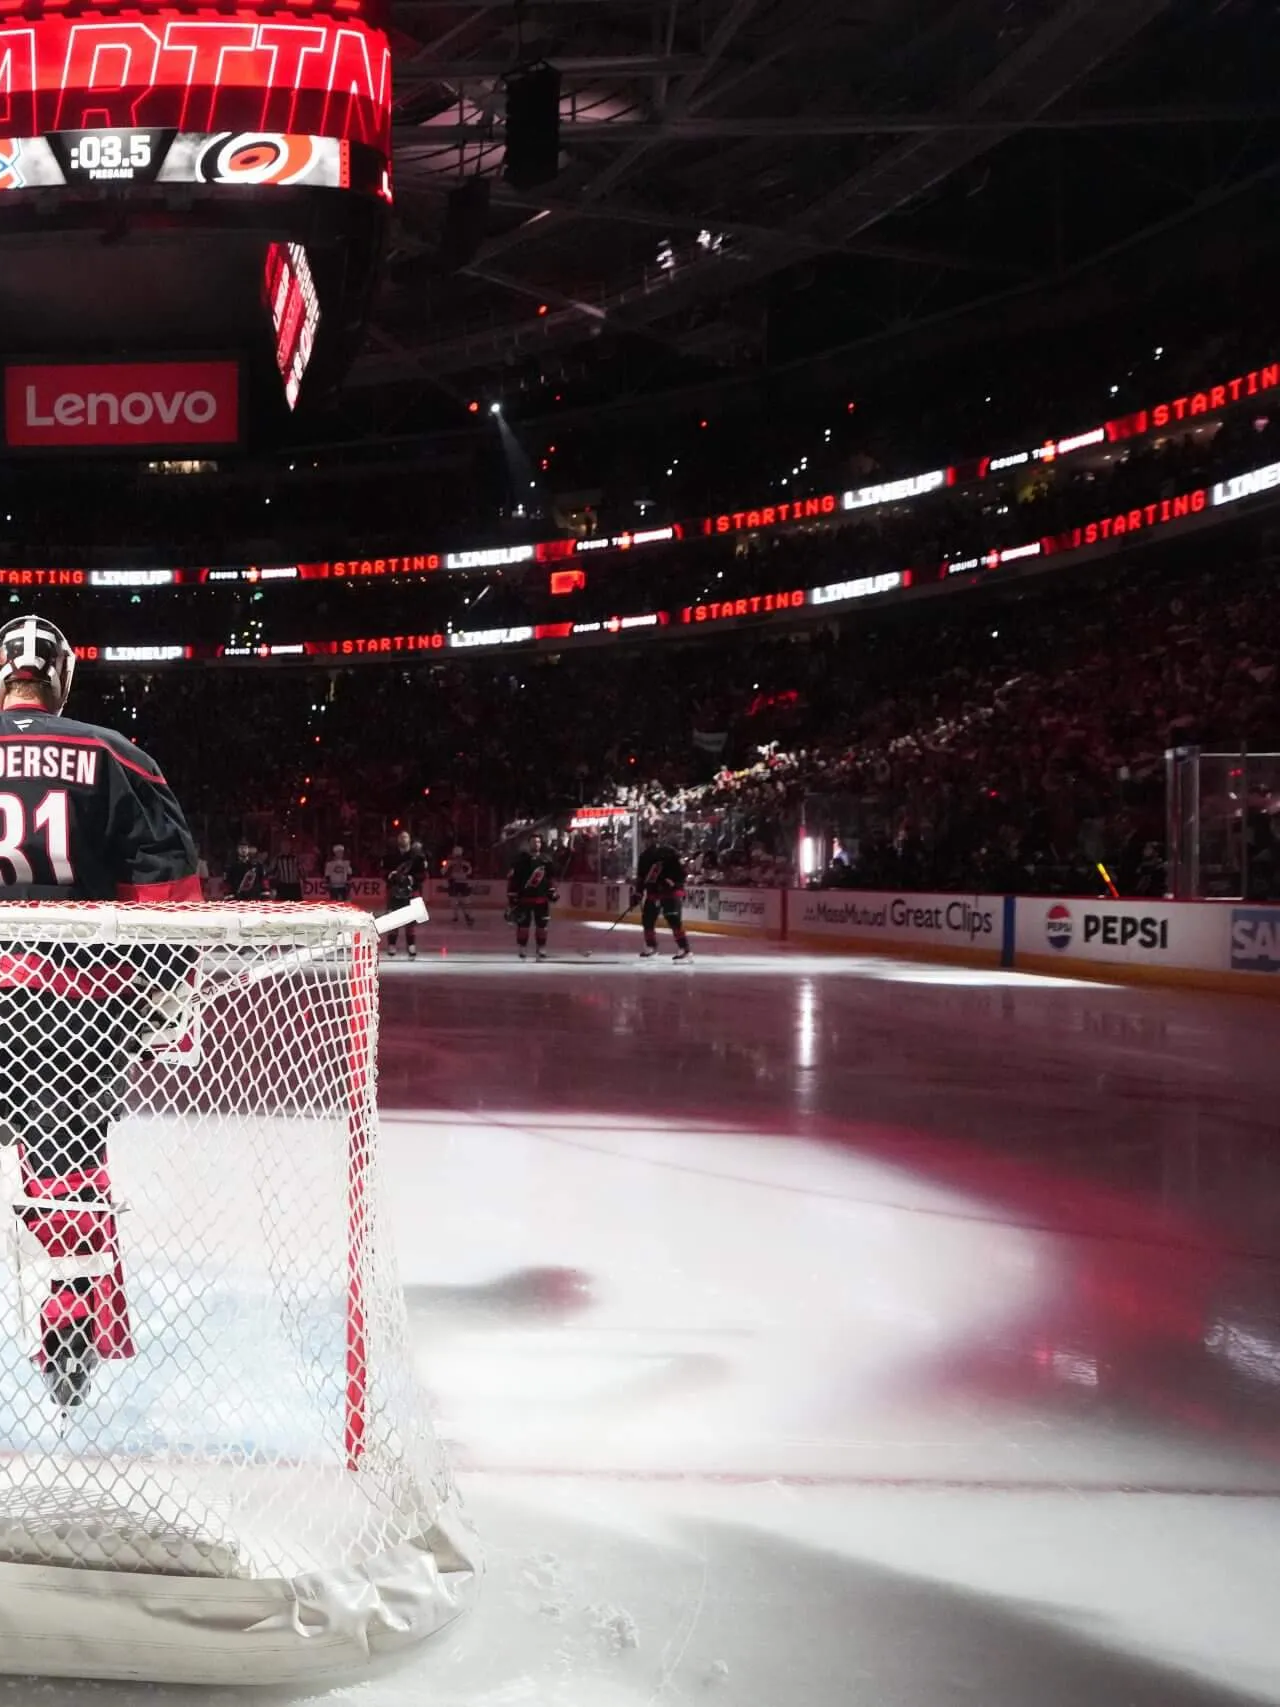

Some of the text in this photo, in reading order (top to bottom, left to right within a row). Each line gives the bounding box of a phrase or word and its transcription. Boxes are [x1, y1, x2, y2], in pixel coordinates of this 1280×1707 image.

[70, 135, 151, 168] :03.5
[26, 385, 217, 426] Lenovo
[716, 470, 943, 532] STARTING LINEUP
[1085, 490, 1206, 543] STARTING
[91, 570, 173, 585] LINEUP
[334, 545, 533, 576] STARTING LINEUP
[695, 571, 901, 621] STARTING LINEUP
[105, 647, 183, 661] LINEUP
[342, 626, 532, 653] STARTING LINEUP
[302, 880, 381, 896] DISVER
[890, 899, 993, 940] Great Clips
[1083, 914, 1168, 949] PEPSI
